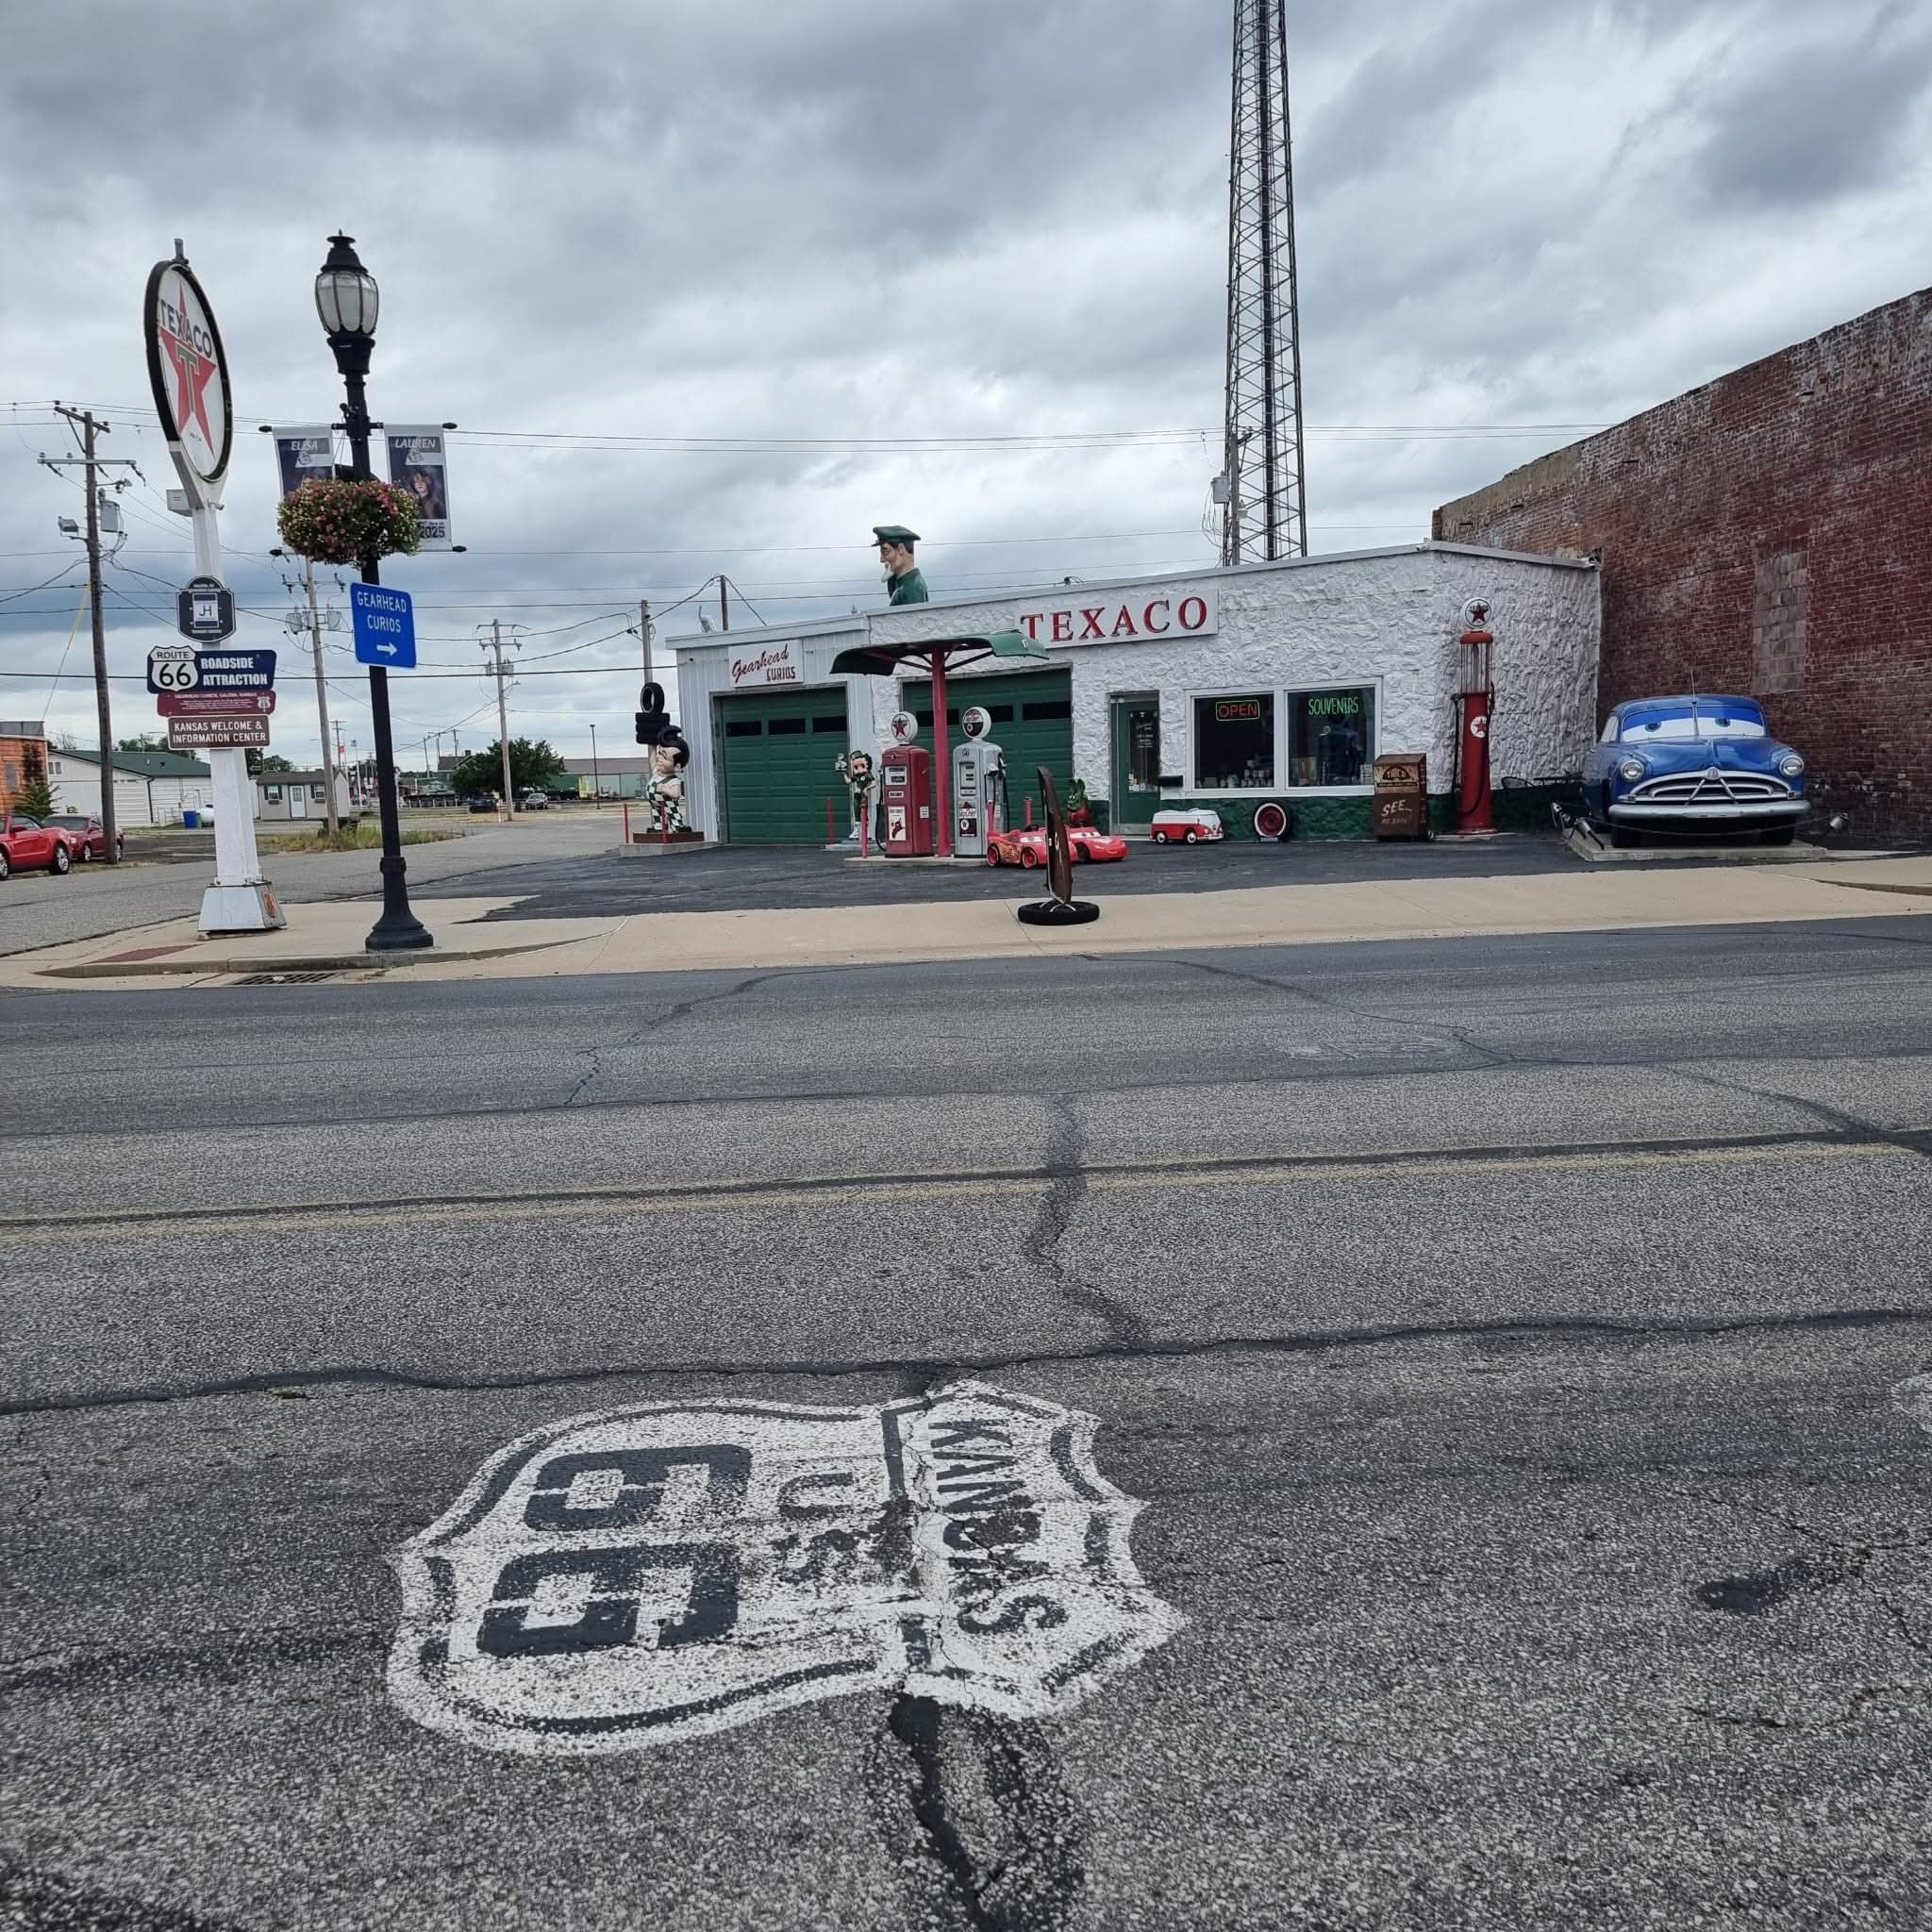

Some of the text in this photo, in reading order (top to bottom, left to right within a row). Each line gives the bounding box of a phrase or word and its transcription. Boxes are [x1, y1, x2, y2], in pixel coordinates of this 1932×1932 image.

[158, 298, 213, 358] TEXACO
[175, 341, 200, 418] T
[291, 440, 318, 451] ELISA
[394, 438, 436, 449] LAUREN
[357, 591, 408, 613] GEARHEAD
[367, 615, 402, 633] CURIOS
[1020, 596, 1208, 642] TEXACO
[157, 651, 190, 659] ROUTE
[732, 642, 790, 684] Gearhead
[200, 658, 255, 670] ROADSIDE
[159, 663, 192, 687] 66
[203, 674, 268, 686] ATTRACTION
[766, 666, 796, 681] CURIOS
[1219, 703, 1257, 718] OPEN
[1308, 696, 1358, 715] SOUVENIRS
[175, 720, 263, 732] KANSAS WELCOME &
[173, 732, 266, 743] INFORMATION CENTER
[475, 1443, 753, 1658] 66
